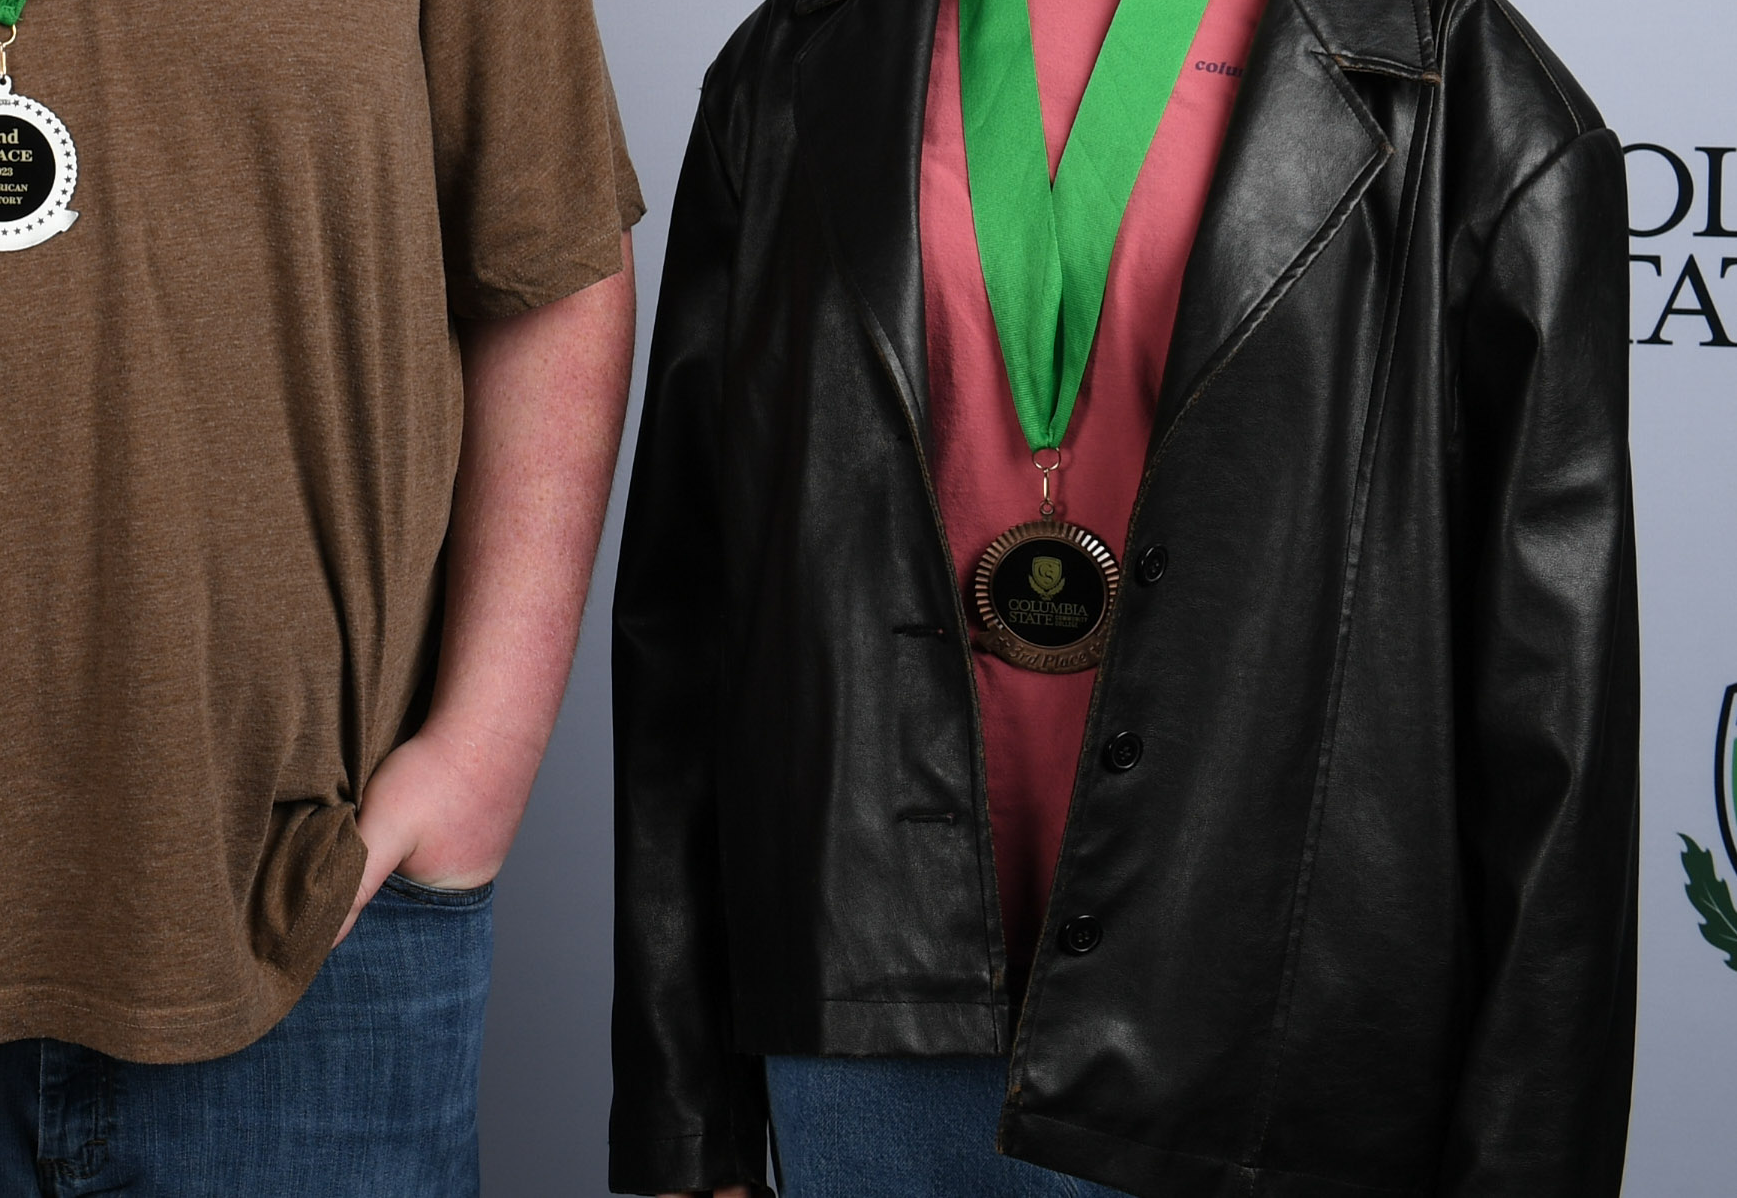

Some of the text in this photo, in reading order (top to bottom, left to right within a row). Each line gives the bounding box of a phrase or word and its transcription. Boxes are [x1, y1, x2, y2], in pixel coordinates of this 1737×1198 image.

[1194, 60, 1244, 78] colu
[1008, 598, 1089, 617] COLUMBIA
[1008, 611, 1055, 627] STATE
[1041, 651, 1089, 669] Place
